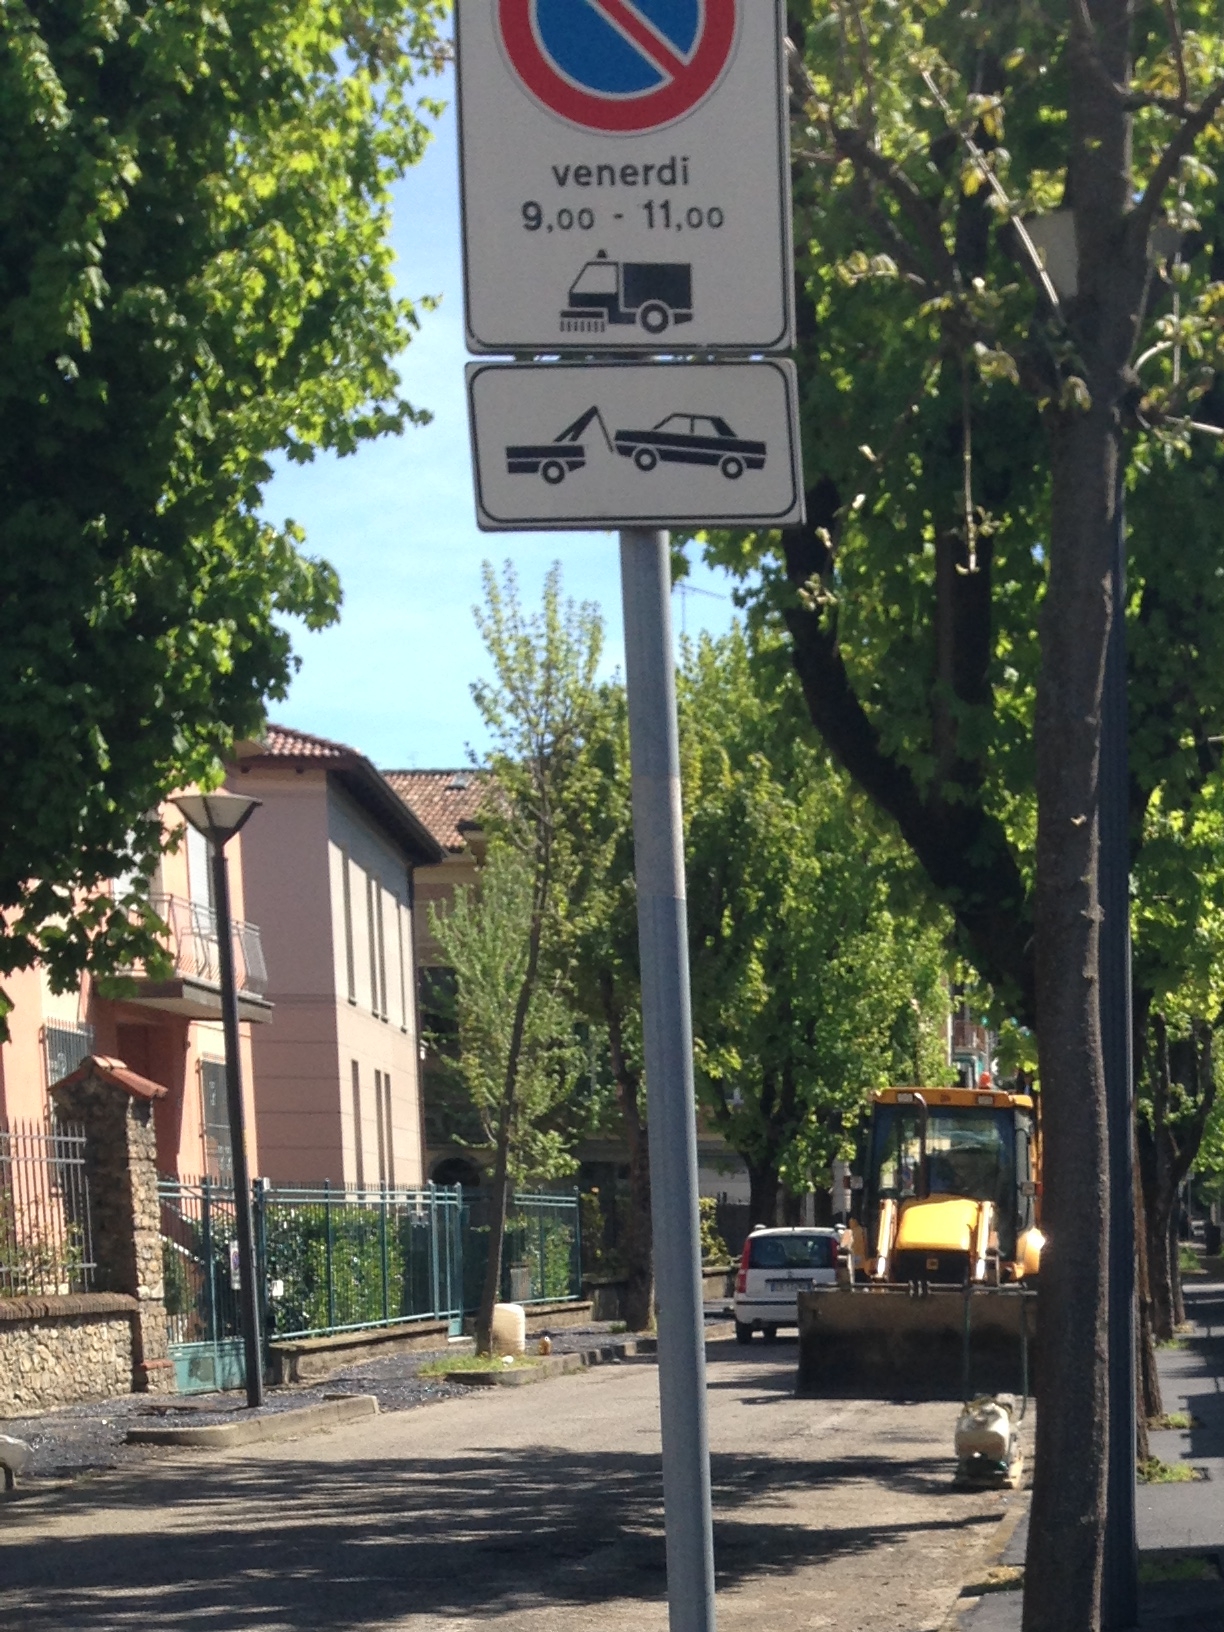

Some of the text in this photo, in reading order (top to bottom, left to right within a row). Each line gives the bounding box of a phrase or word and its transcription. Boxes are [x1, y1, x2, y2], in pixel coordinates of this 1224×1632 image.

[551, 155, 690, 187] venerdi
[521, 200, 595, 233] 9,00
[641, 199, 725, 232] 11,00
